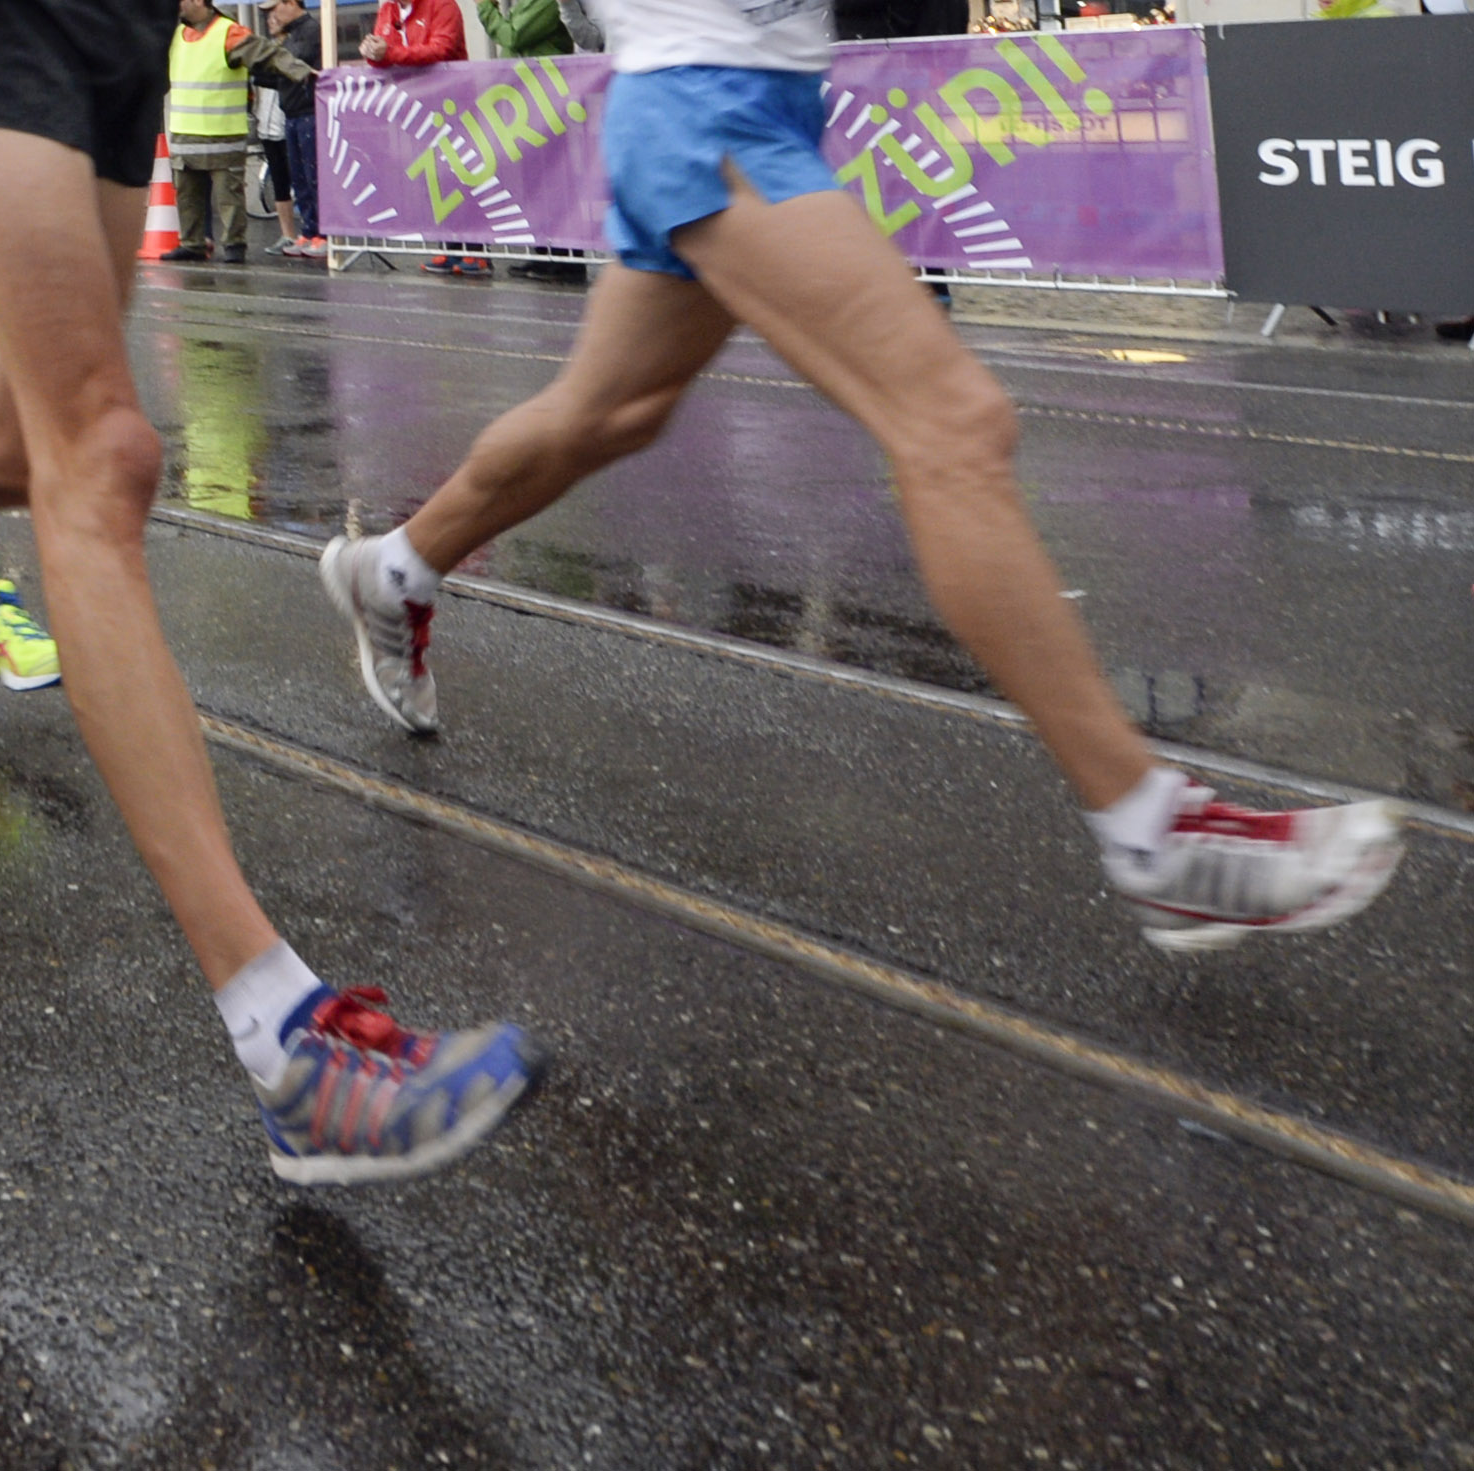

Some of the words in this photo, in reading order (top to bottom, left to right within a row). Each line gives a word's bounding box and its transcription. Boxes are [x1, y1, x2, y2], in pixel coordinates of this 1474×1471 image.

[406, 56, 587, 225] ZÜRI!
[833, 34, 1114, 239] ZÜRI!
[1258, 137, 1445, 188] STEIG
